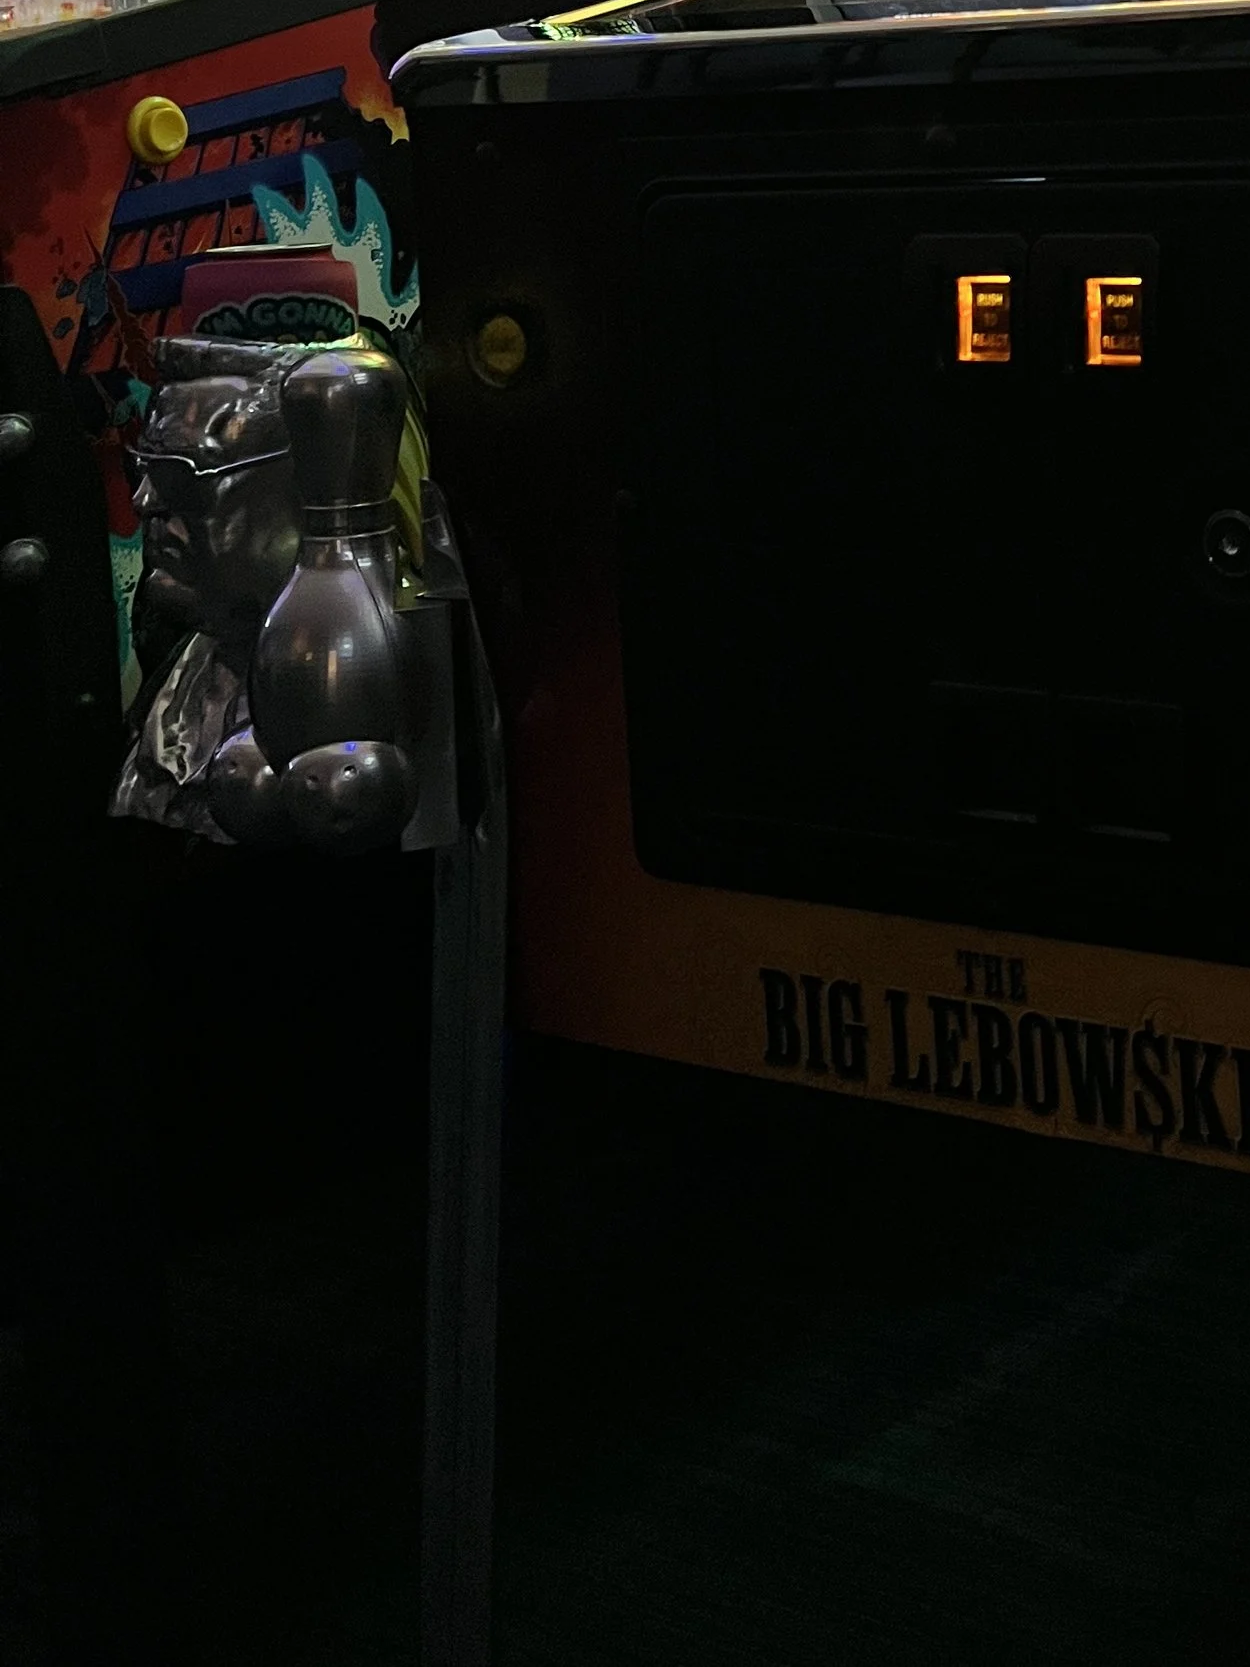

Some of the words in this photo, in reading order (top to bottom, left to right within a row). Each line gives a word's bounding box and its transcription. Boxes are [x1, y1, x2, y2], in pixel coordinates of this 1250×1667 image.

[977, 293, 1003, 306] PUSH
[1106, 294, 1133, 307] PUSH
[252, 301, 353, 334] GONNA
[957, 949, 1027, 1003] THE
[760, 967, 868, 1081] BIG
